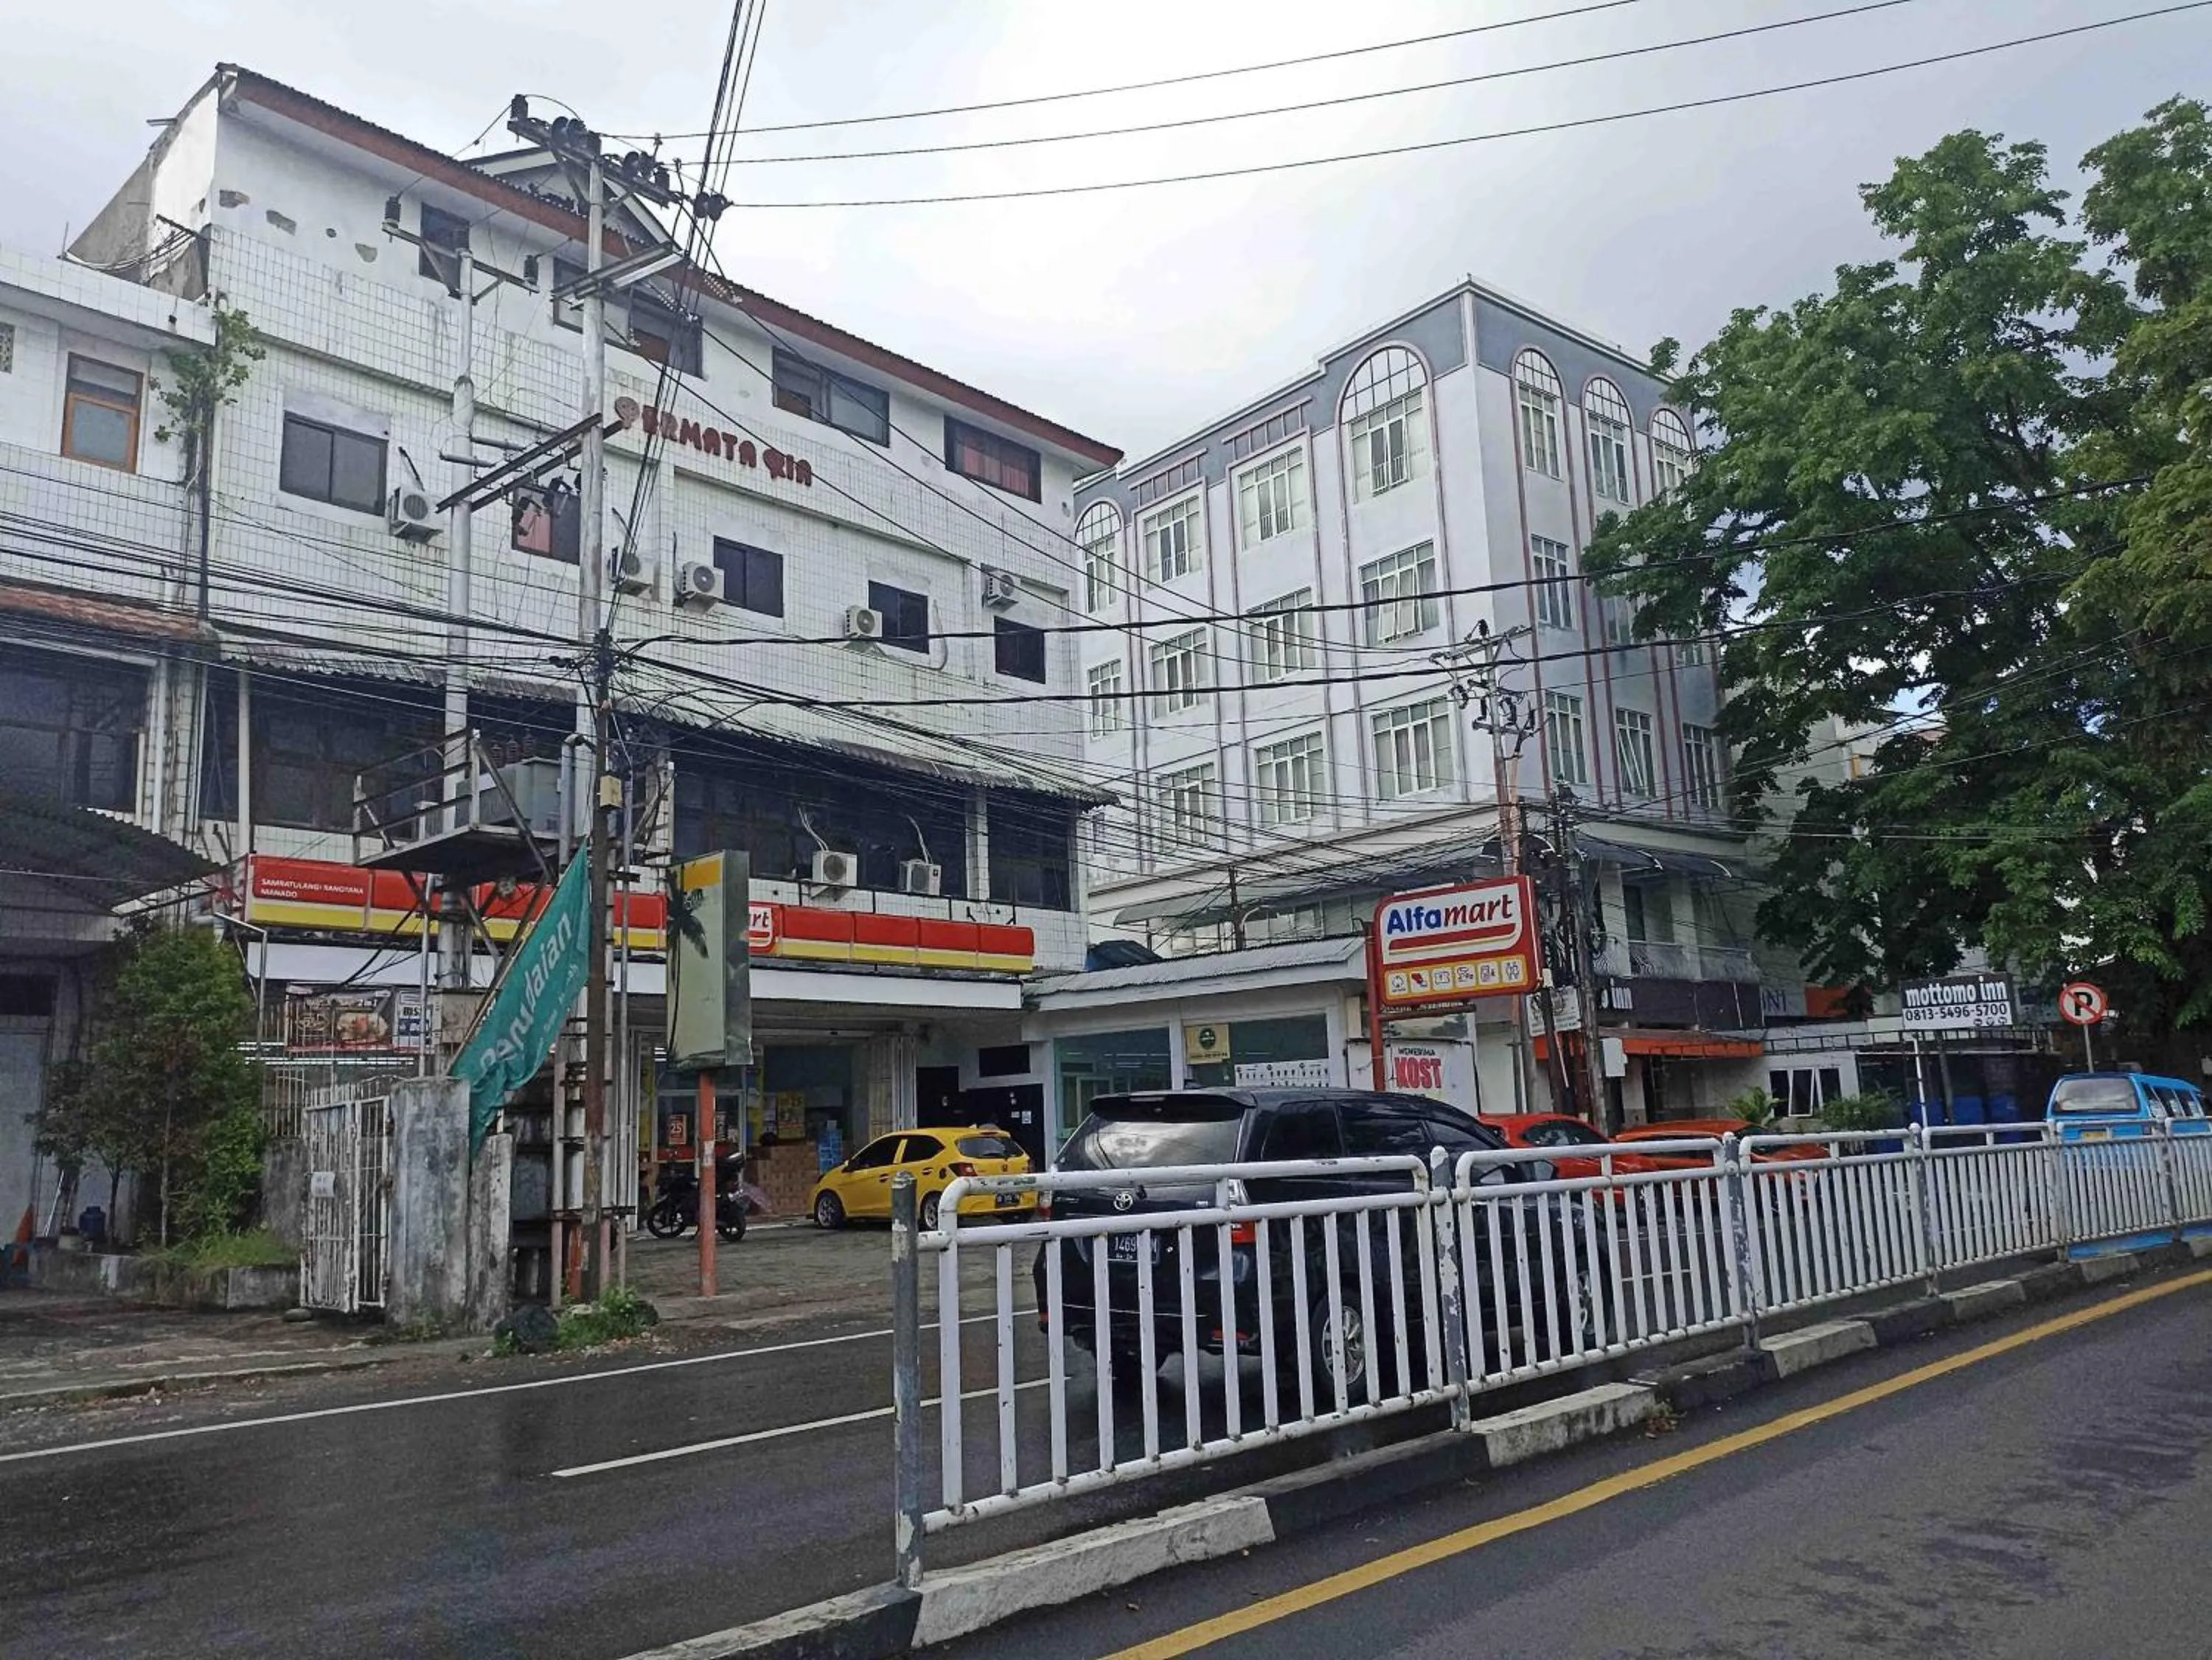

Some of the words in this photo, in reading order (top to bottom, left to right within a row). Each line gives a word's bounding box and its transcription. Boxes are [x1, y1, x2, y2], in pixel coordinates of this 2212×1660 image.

[260, 888, 298, 899] MANADO
[1387, 893, 1514, 935] Alfamart
[1905, 983, 1977, 1008] mottomo
[1978, 975, 2008, 1001] inn
[2074, 991, 2093, 1016] P
[1905, 1003, 2008, 1022] 0813-5496-5700
[1394, 1056, 1442, 1089] KOST
